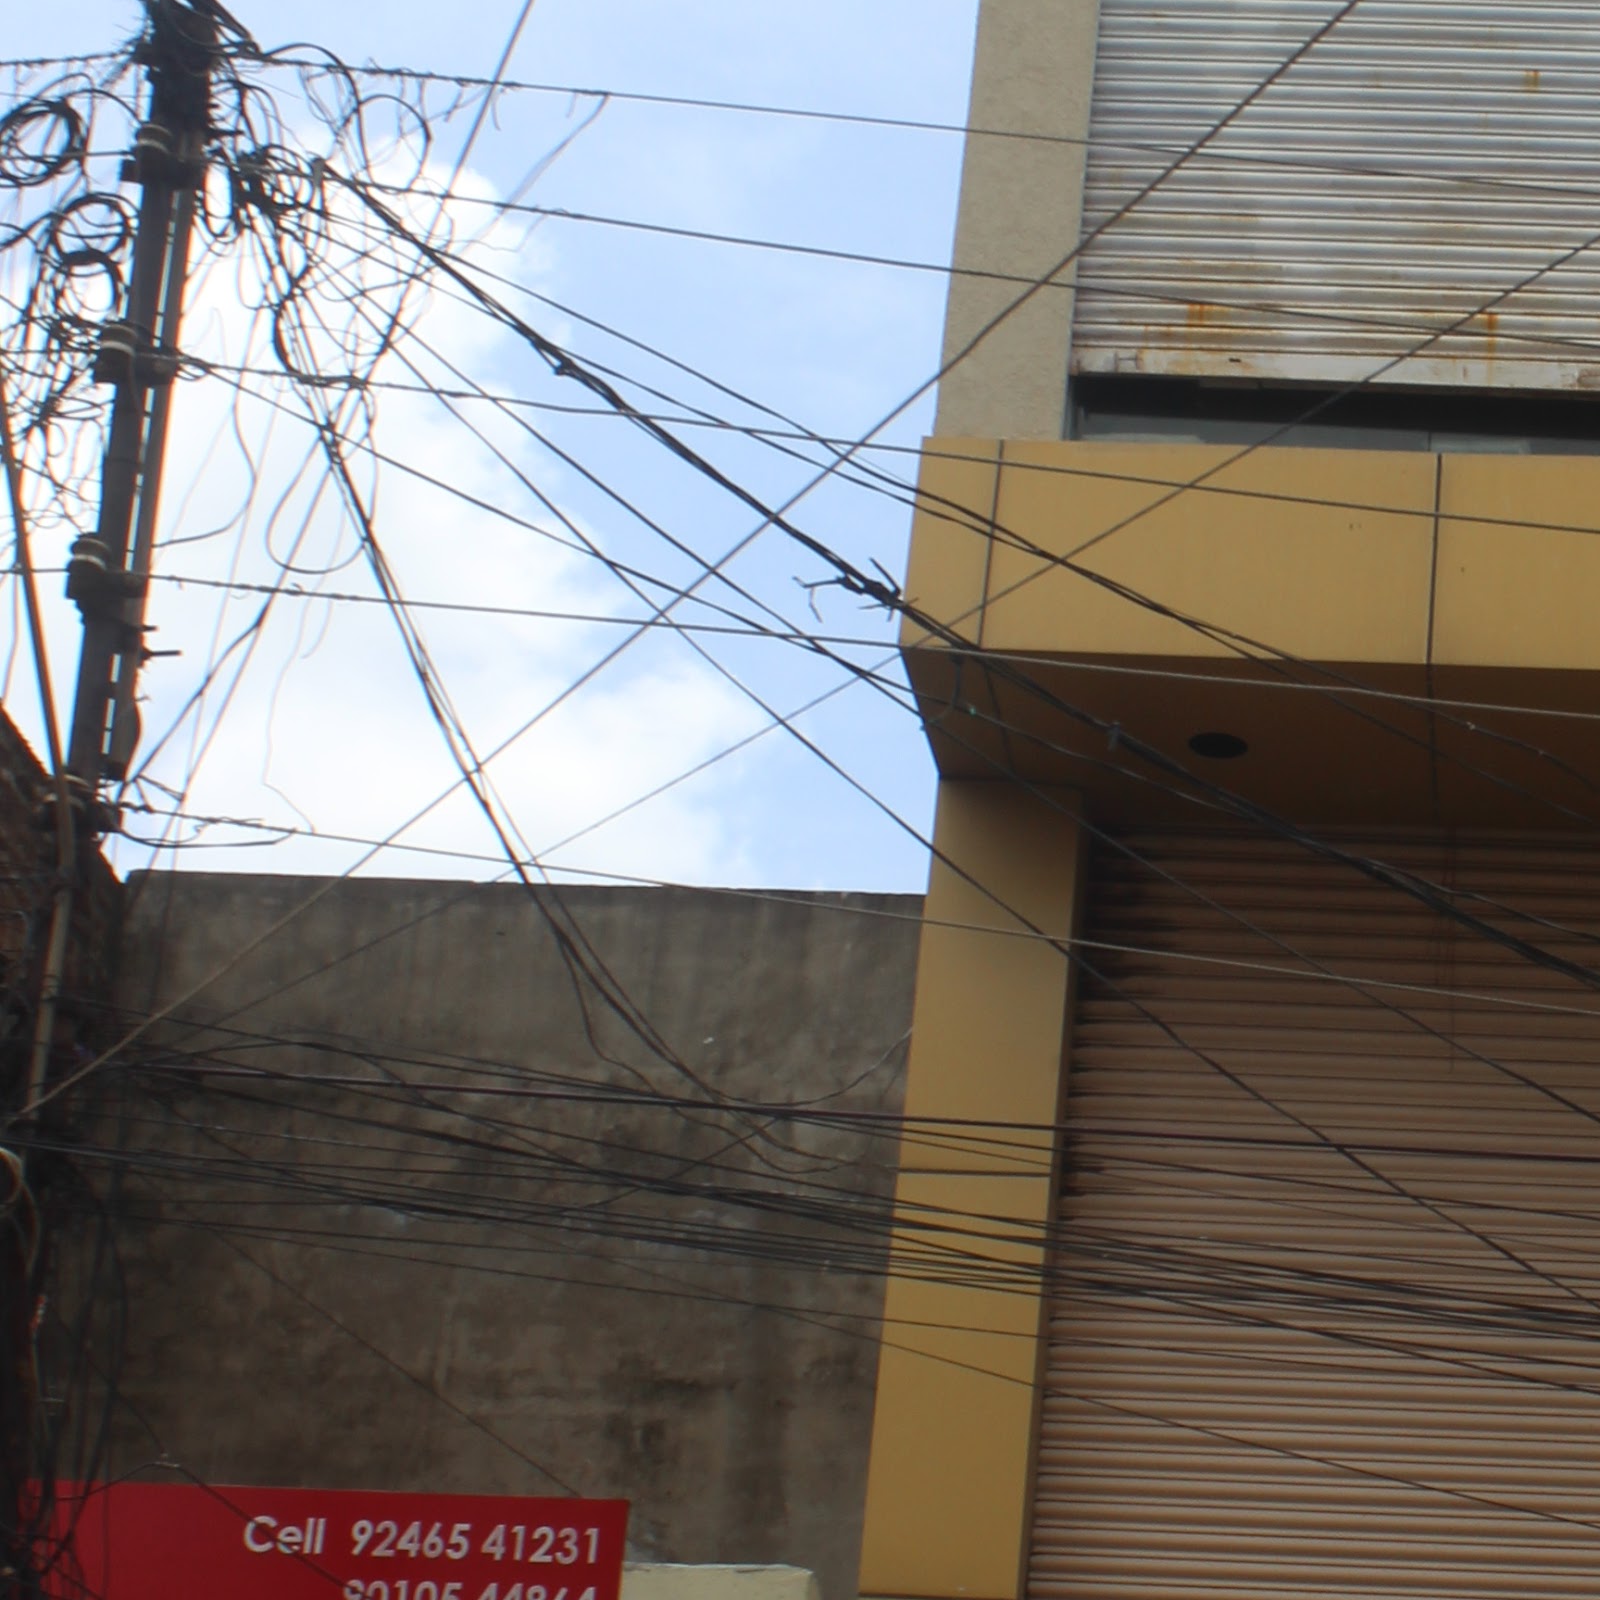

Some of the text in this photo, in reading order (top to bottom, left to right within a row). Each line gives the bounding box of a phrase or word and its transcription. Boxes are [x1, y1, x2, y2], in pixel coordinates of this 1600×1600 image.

[243, 1515, 602, 1565] Cell 92465 41231
